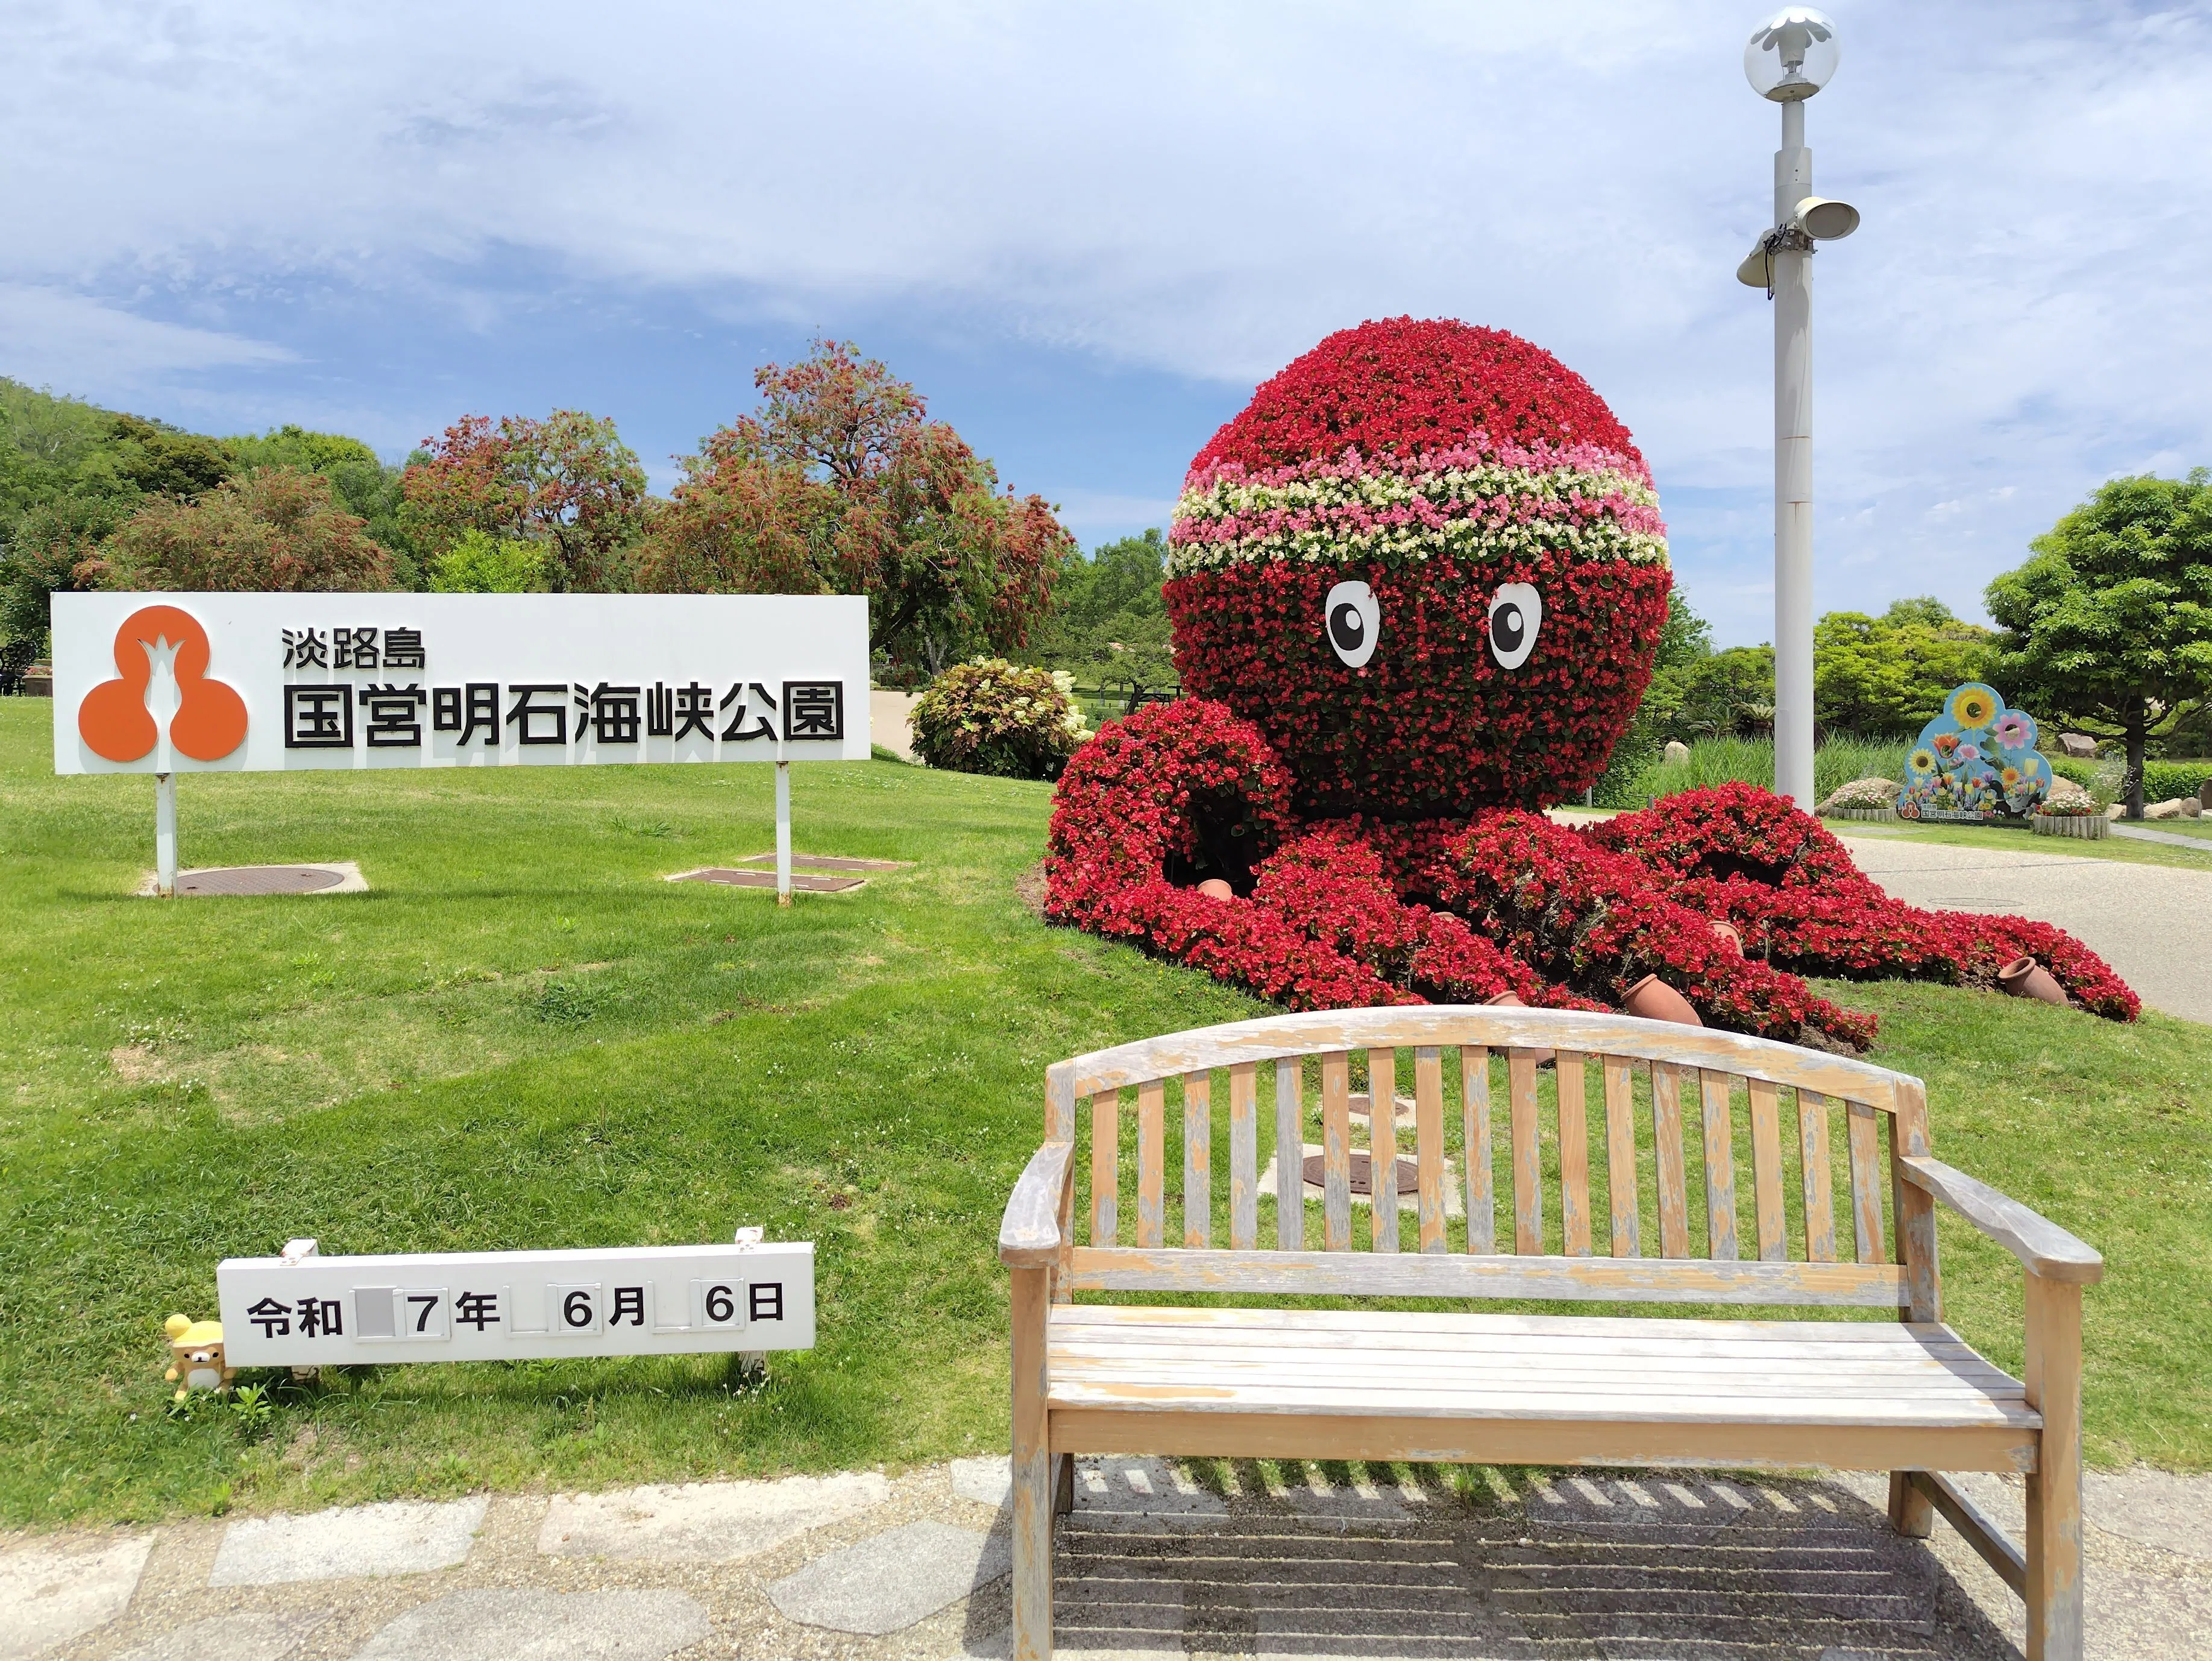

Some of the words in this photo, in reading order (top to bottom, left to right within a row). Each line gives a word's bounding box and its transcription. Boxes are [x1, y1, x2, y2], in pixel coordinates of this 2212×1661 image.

[281, 626, 426, 669] 淡路島
[283, 681, 844, 749] 国営明石海峡公園
[247, 1296, 343, 1338] 令和
